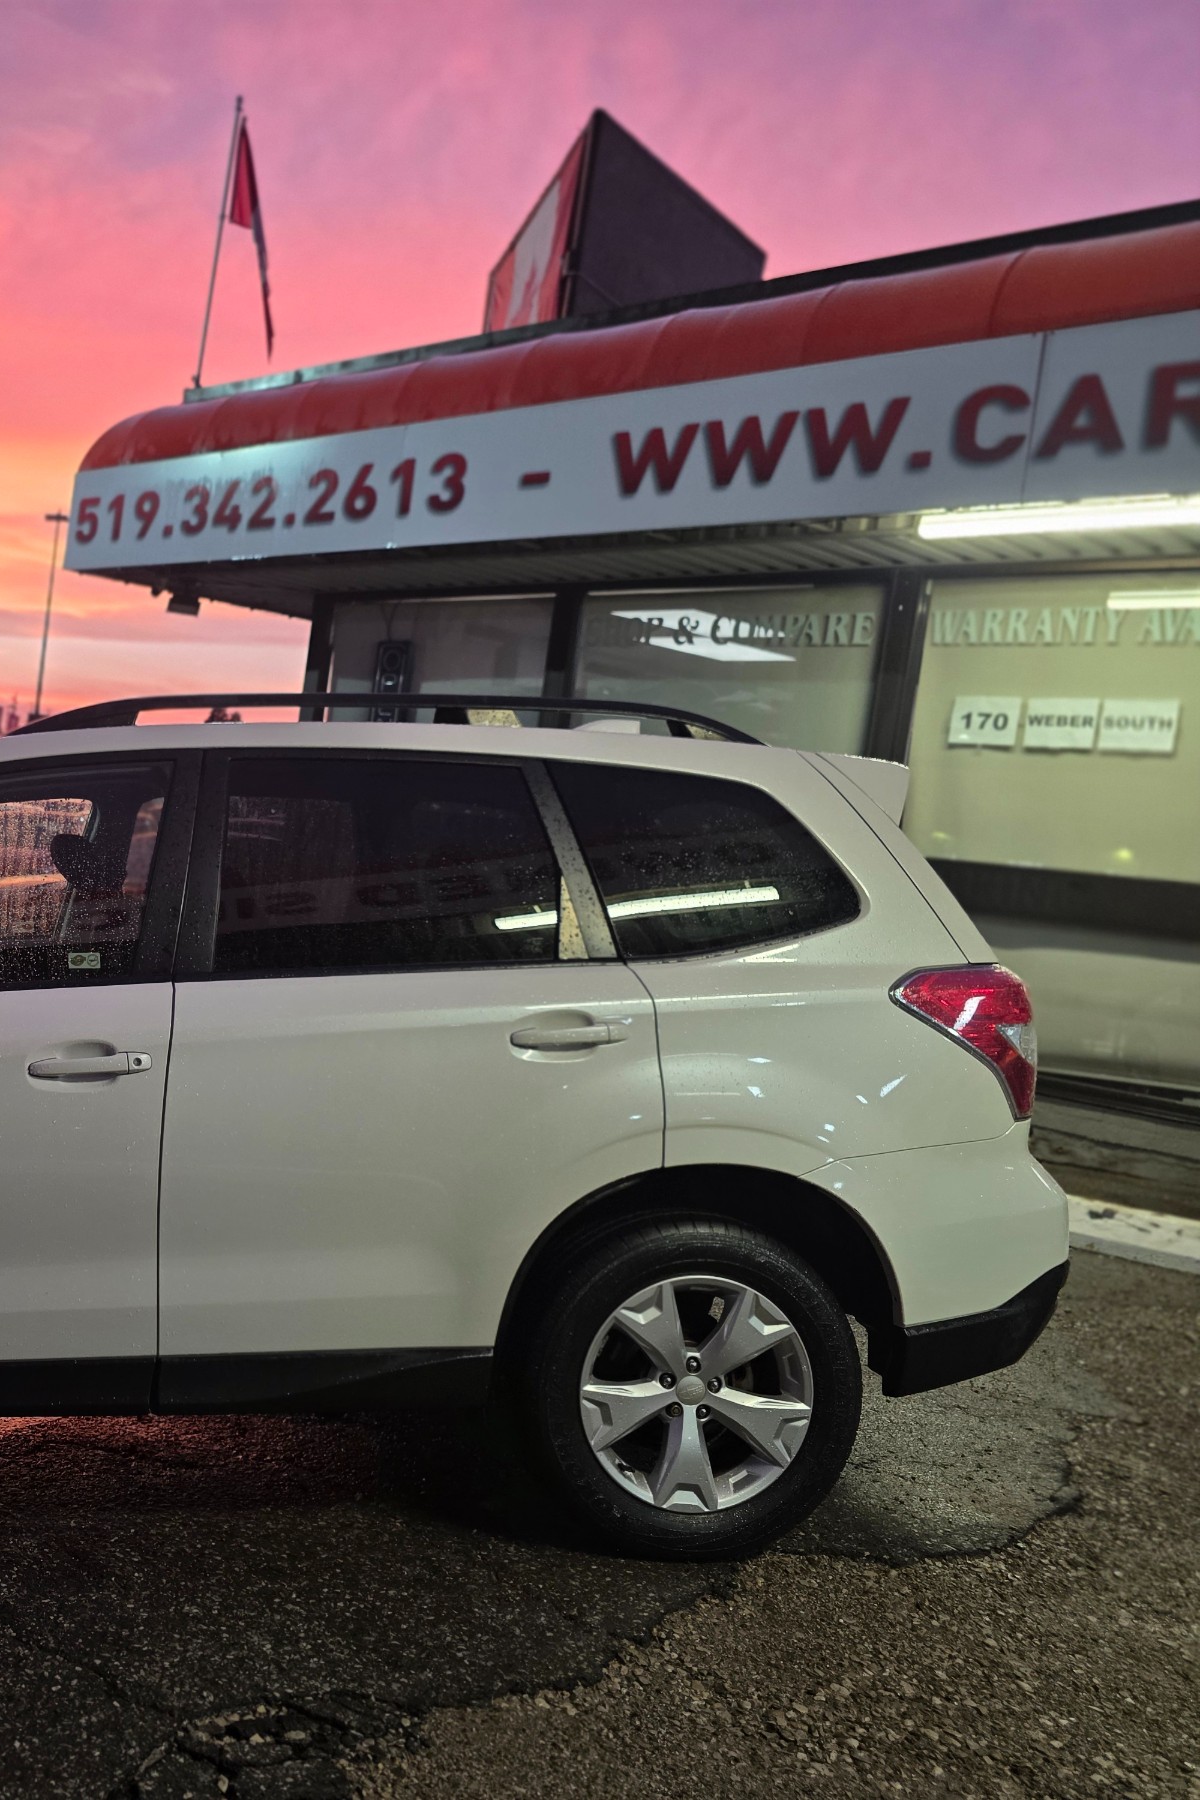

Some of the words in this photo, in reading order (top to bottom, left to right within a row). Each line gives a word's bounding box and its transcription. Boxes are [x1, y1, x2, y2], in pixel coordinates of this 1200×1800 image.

[74, 450, 469, 547] 519.342.2613
[710, 611, 876, 647] COMPARE
[931, 606, 1127, 646] WARRANTY
[960, 712, 1008, 731] 170
[1027, 714, 1094, 729] WEBER
[1104, 715, 1173, 731] SOUTH
